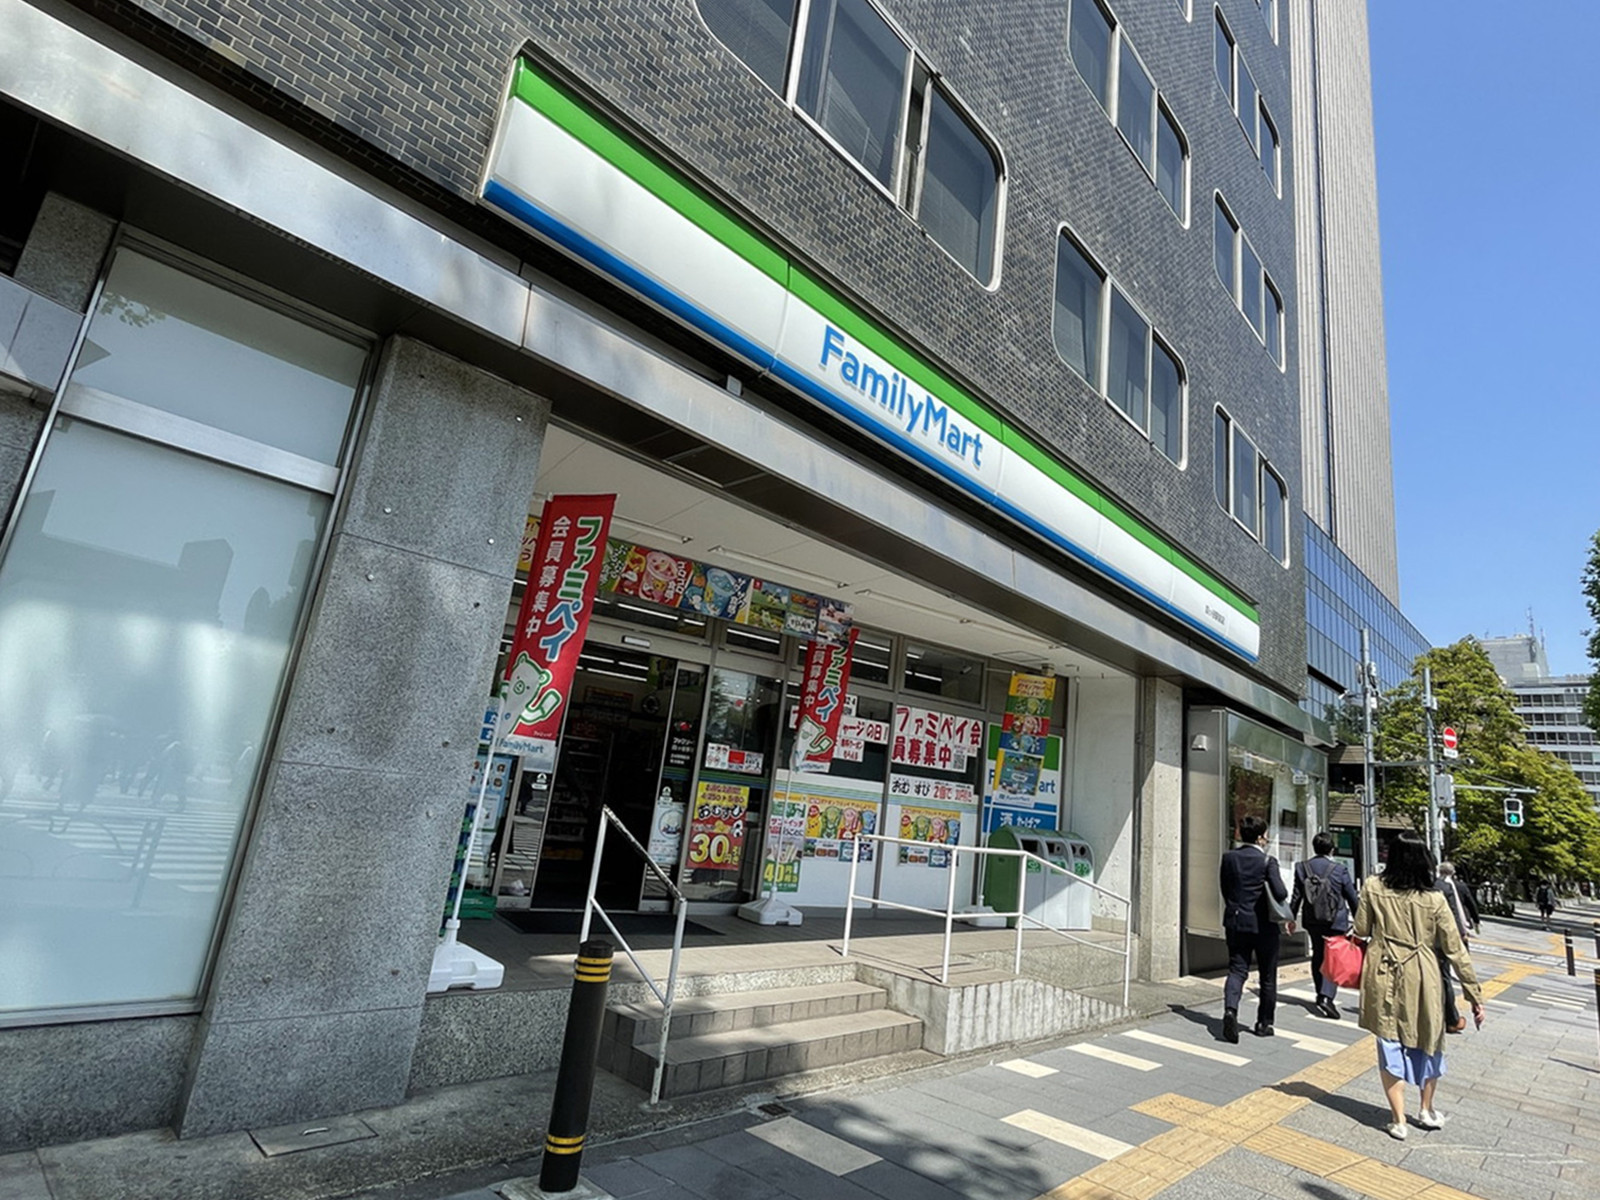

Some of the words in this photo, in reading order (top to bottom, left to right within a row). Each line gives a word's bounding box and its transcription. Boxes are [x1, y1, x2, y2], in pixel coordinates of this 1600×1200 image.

[819, 324, 984, 467] FamilyMart
[525, 516, 571, 638] 会員募集中
[540, 516, 603, 662] ファミペイ
[892, 735, 951, 769] 員募集中
